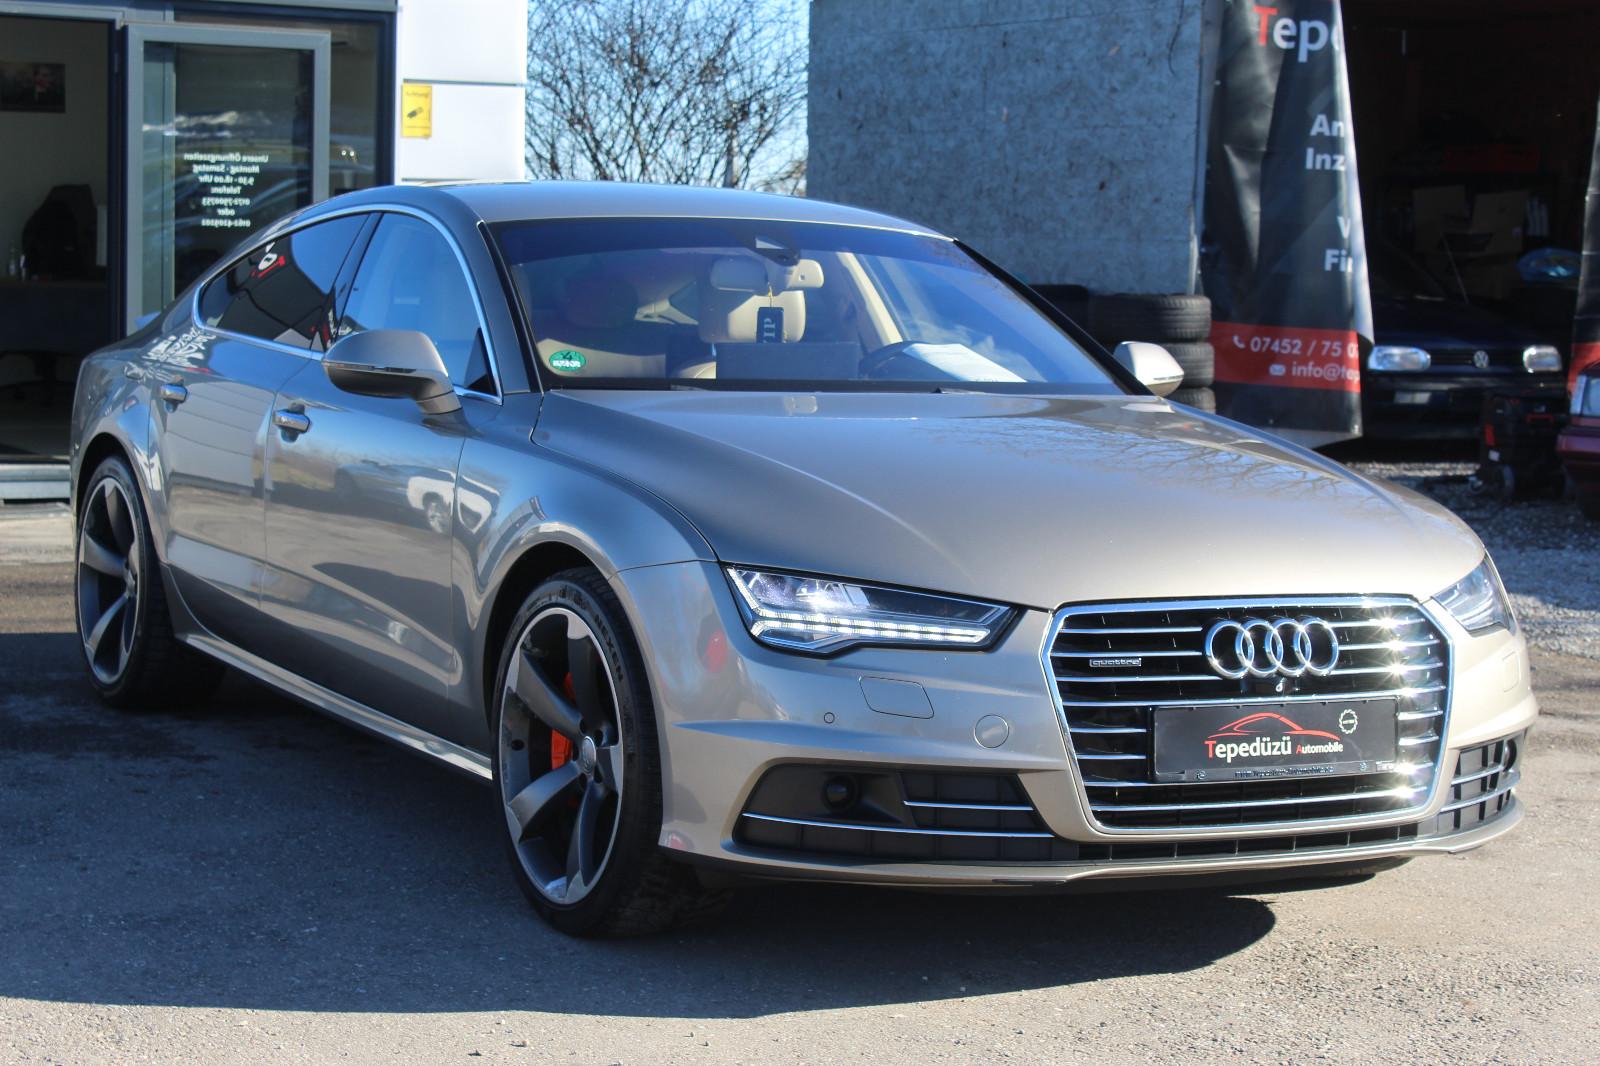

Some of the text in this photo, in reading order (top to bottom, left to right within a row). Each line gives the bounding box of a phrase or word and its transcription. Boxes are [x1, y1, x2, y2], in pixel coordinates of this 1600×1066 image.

[1305, 148, 1346, 171] Inz
[1250, 336, 1302, 355] 07452
[1307, 341, 1317, 357] /
[1321, 341, 1343, 357] 75
[594, 614, 623, 682] NEXEN
[1091, 658, 1141, 667] quattro
[1204, 736, 1344, 763] Tepedüzü Automobile
